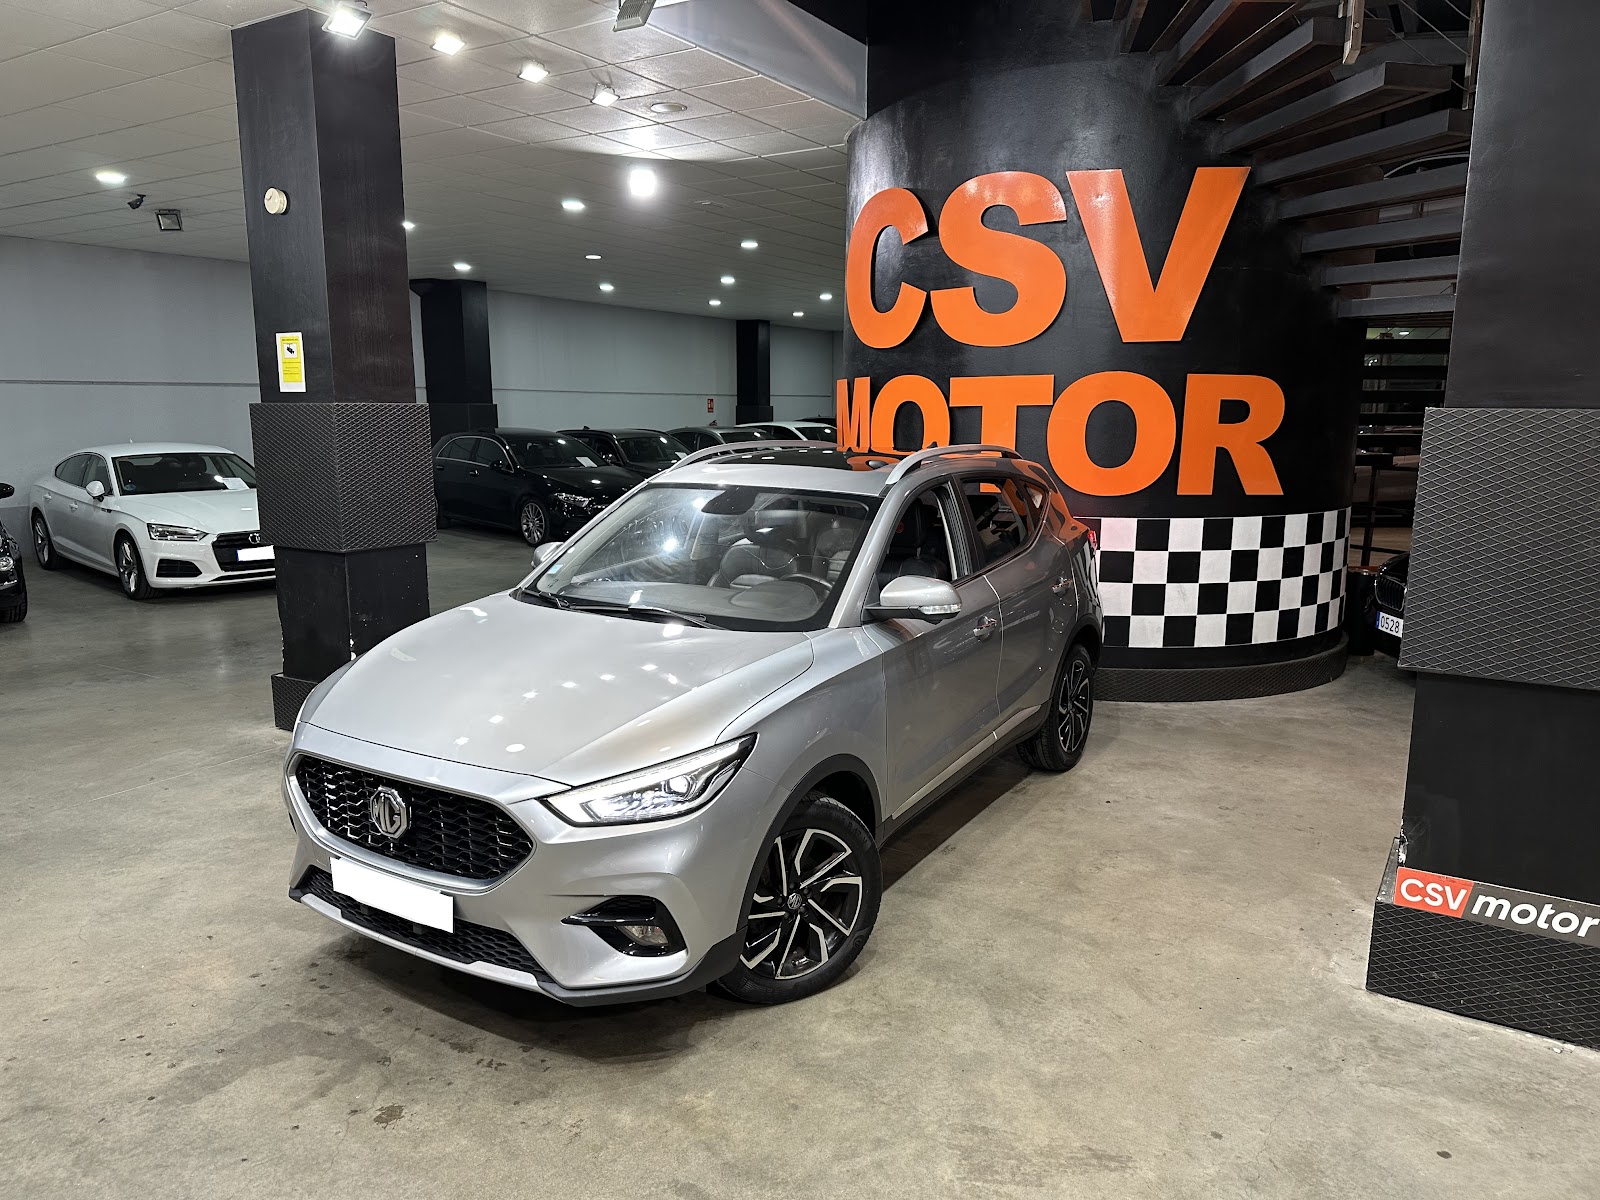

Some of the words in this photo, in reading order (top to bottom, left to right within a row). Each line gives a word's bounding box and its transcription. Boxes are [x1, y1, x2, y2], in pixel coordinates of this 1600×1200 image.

[846, 166, 1252, 348] CSV
[836, 371, 1286, 496] MOTOR
[1380, 615, 1400, 634] 0528
[372, 792, 402, 834] MG
[1400, 878, 1467, 911] CSV
[1471, 893, 1600, 937] motor
